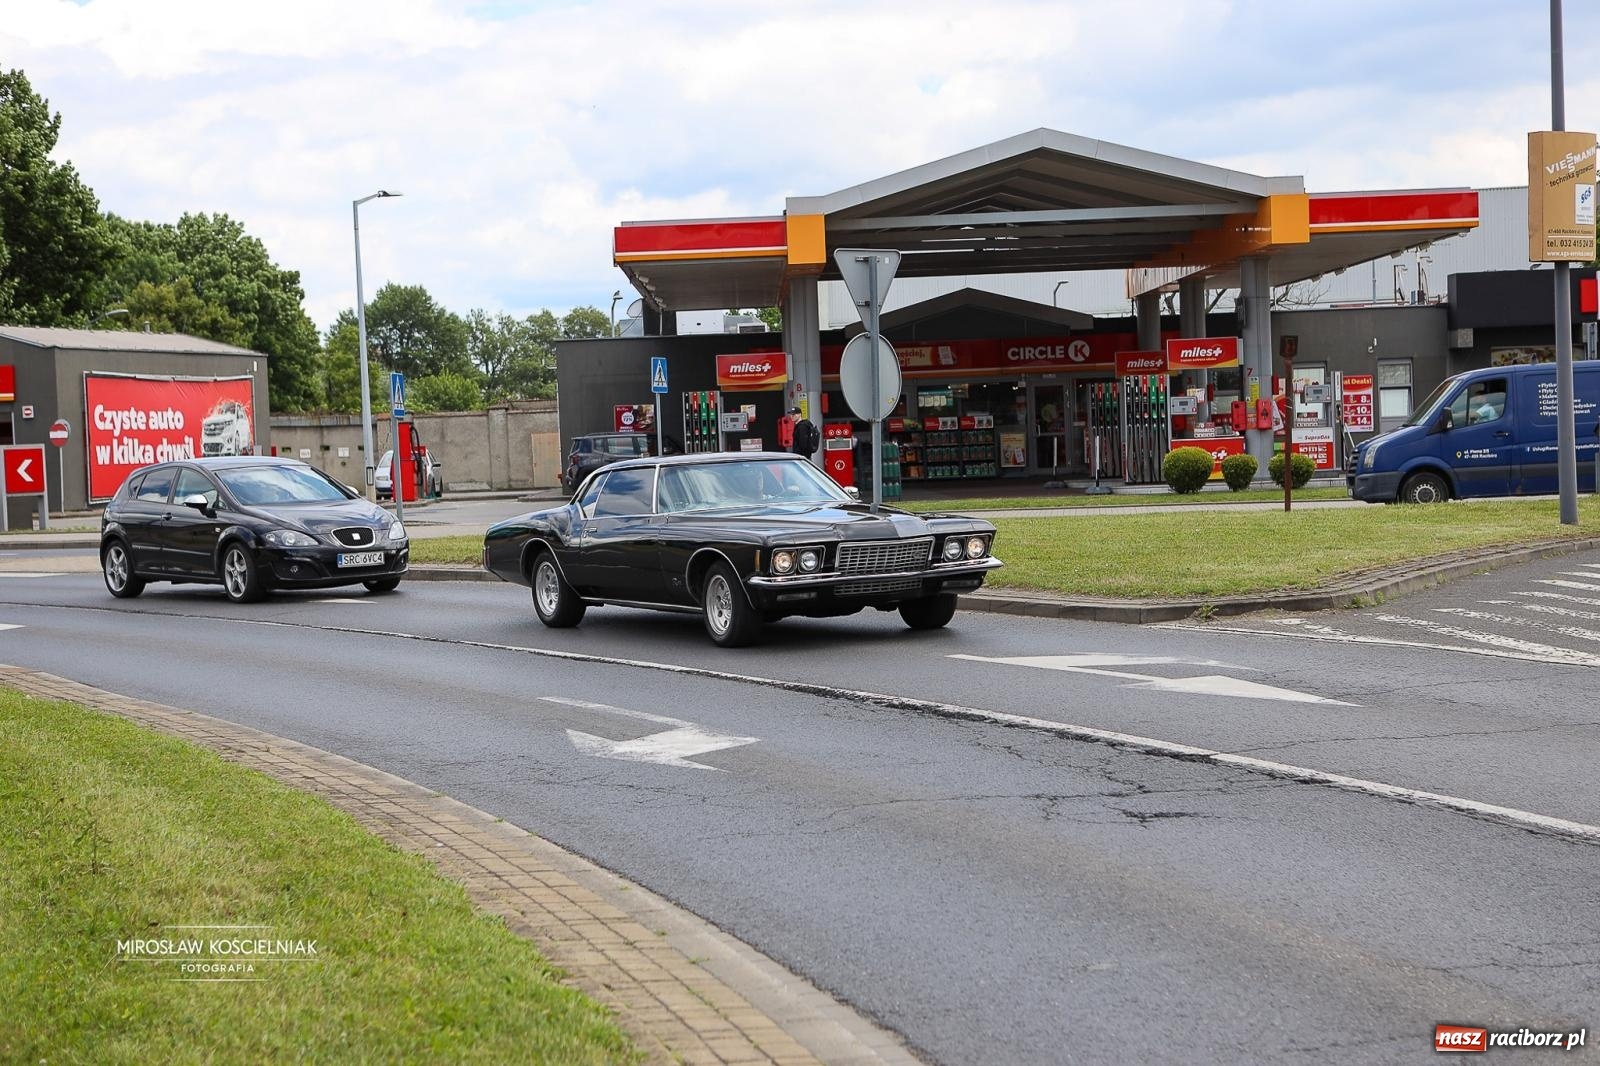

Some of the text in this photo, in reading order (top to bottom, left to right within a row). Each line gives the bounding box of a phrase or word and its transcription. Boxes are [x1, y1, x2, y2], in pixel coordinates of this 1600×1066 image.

[1549, 171, 1575, 188] technika
[1008, 340, 1091, 361] CIRCLE K
[1356, 406, 1367, 414] 10
[95, 405, 184, 436] Czyste auto
[1356, 417, 1367, 425] 14
[96, 445, 111, 465] w
[113, 437, 155, 464] kilka
[344, 554, 361, 565] SRC
